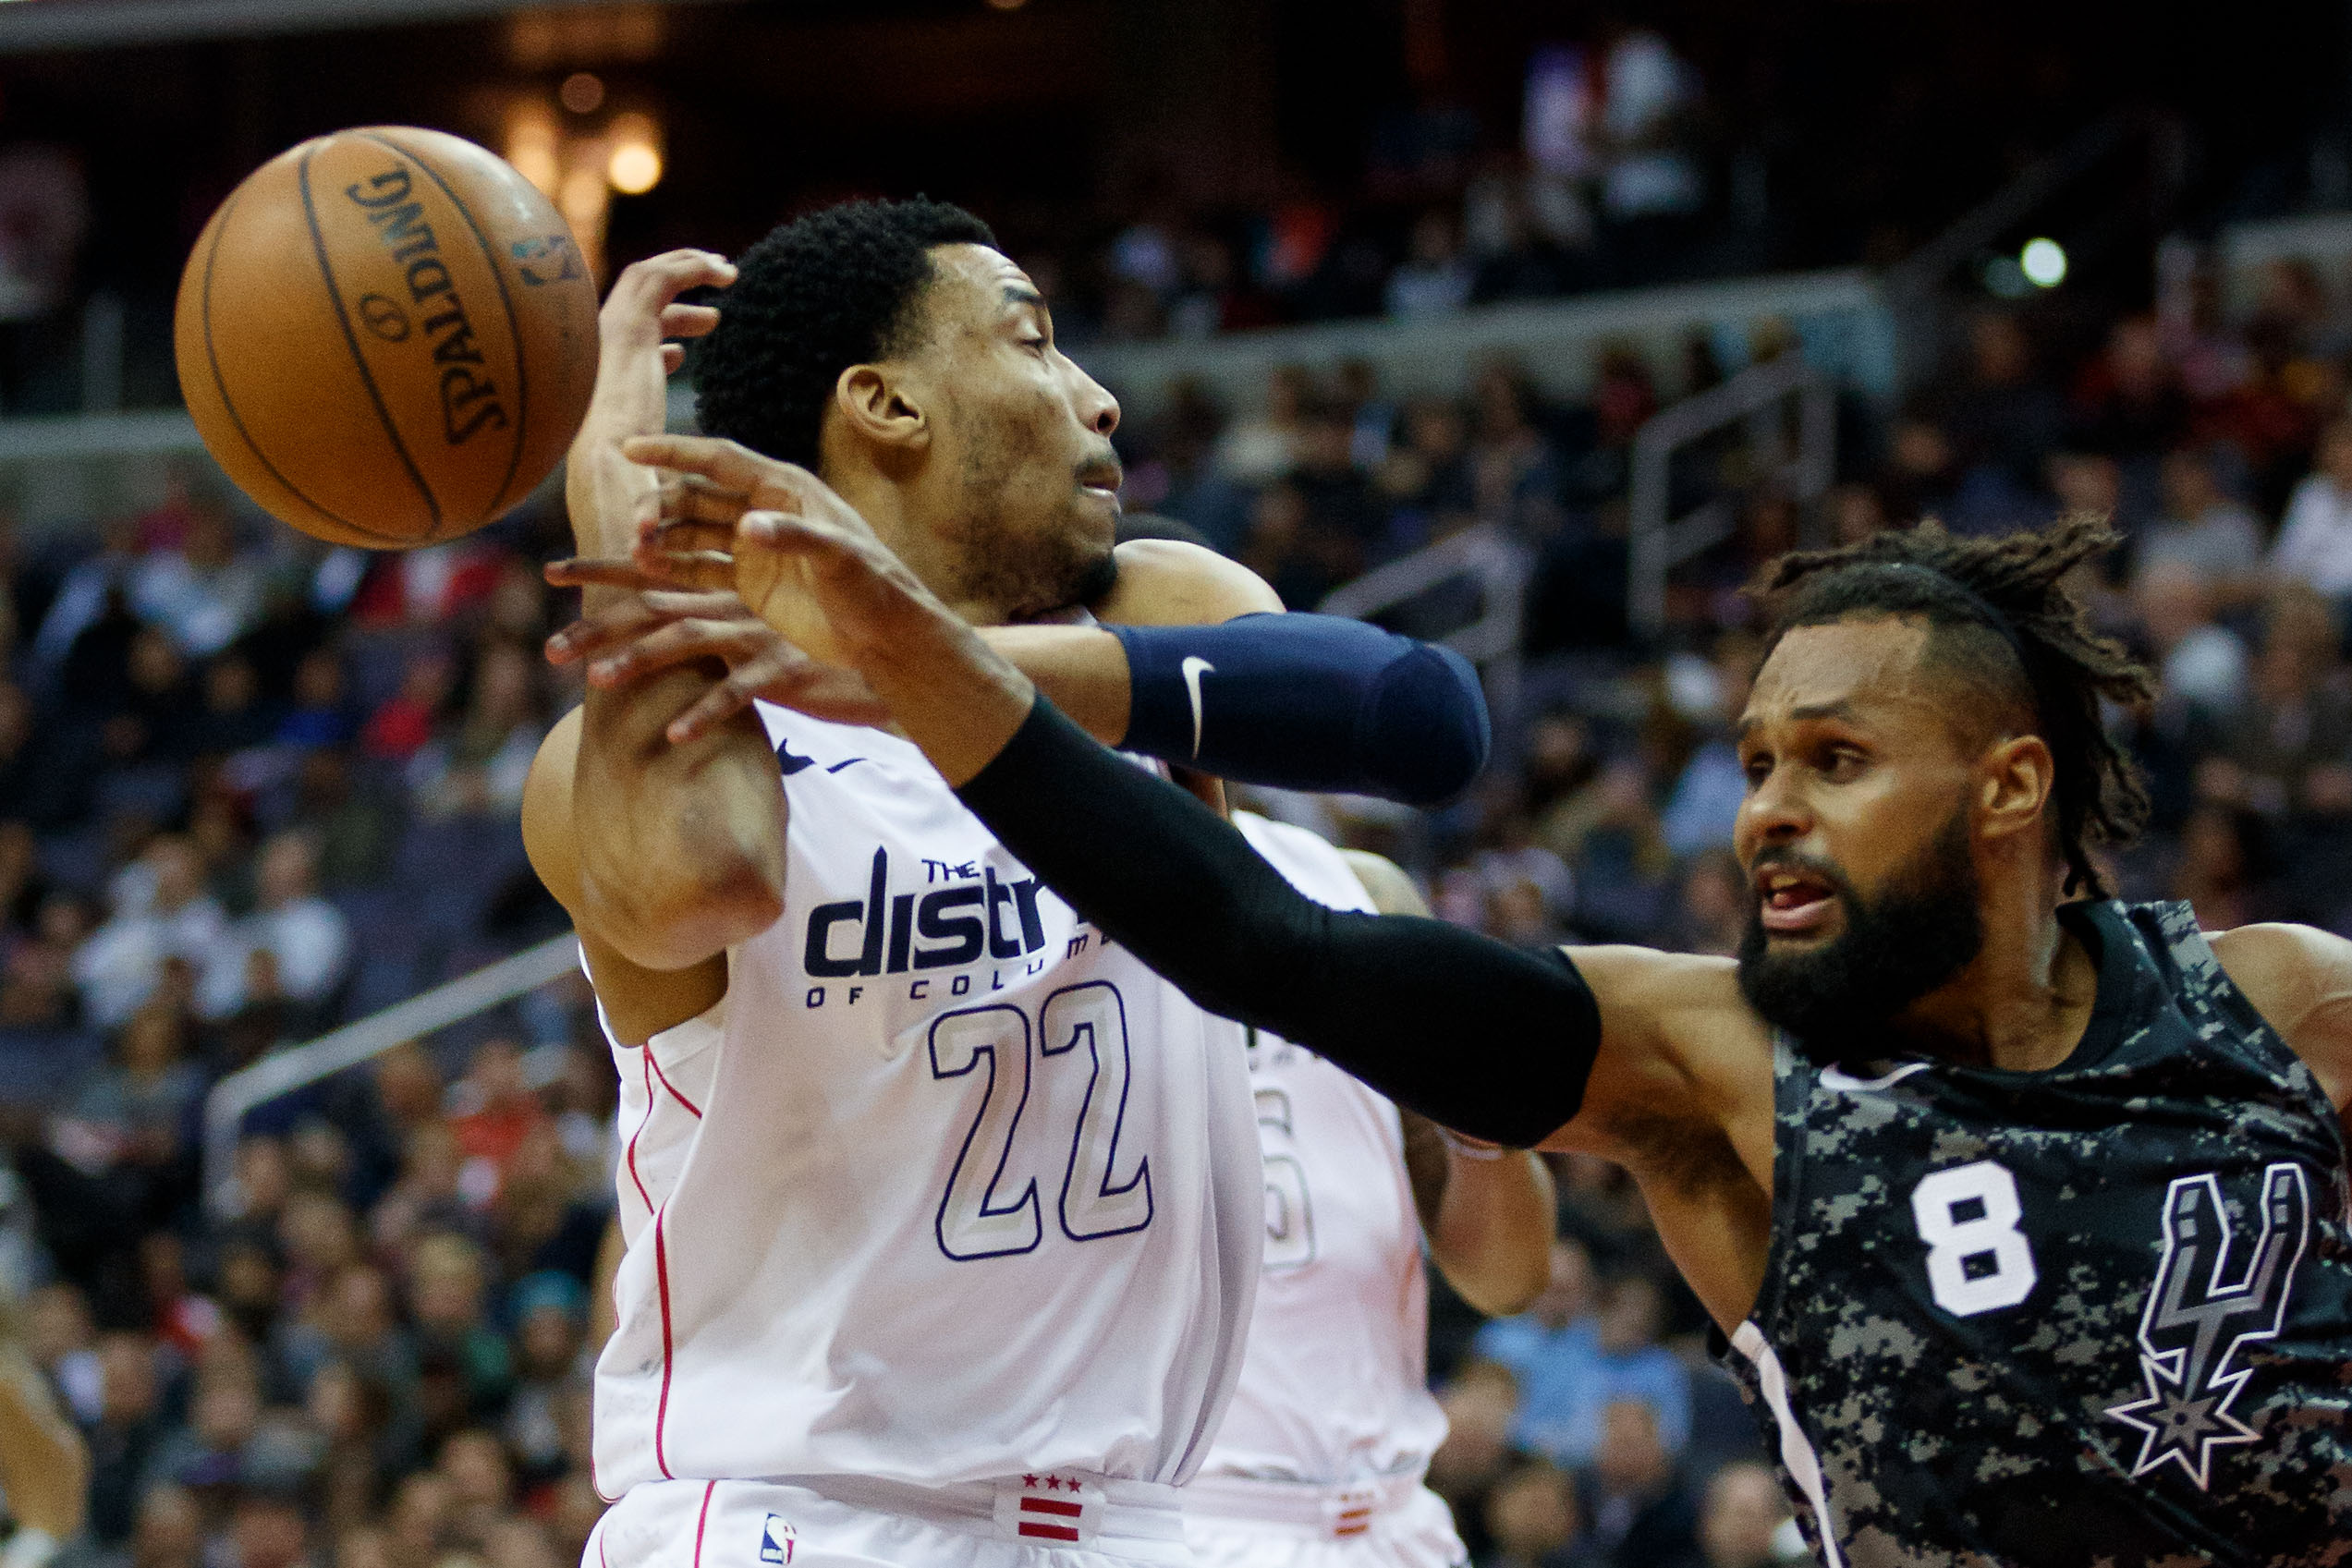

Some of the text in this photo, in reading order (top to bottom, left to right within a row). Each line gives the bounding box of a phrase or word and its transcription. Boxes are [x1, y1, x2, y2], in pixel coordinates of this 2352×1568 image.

[344, 162, 509, 446] SPALDING
[804, 845, 1049, 979] distr
[920, 857, 981, 884] THE
[806, 986, 864, 1010] OF
[927, 979, 1154, 1263] 22
[1910, 1160, 2039, 1318] 8
